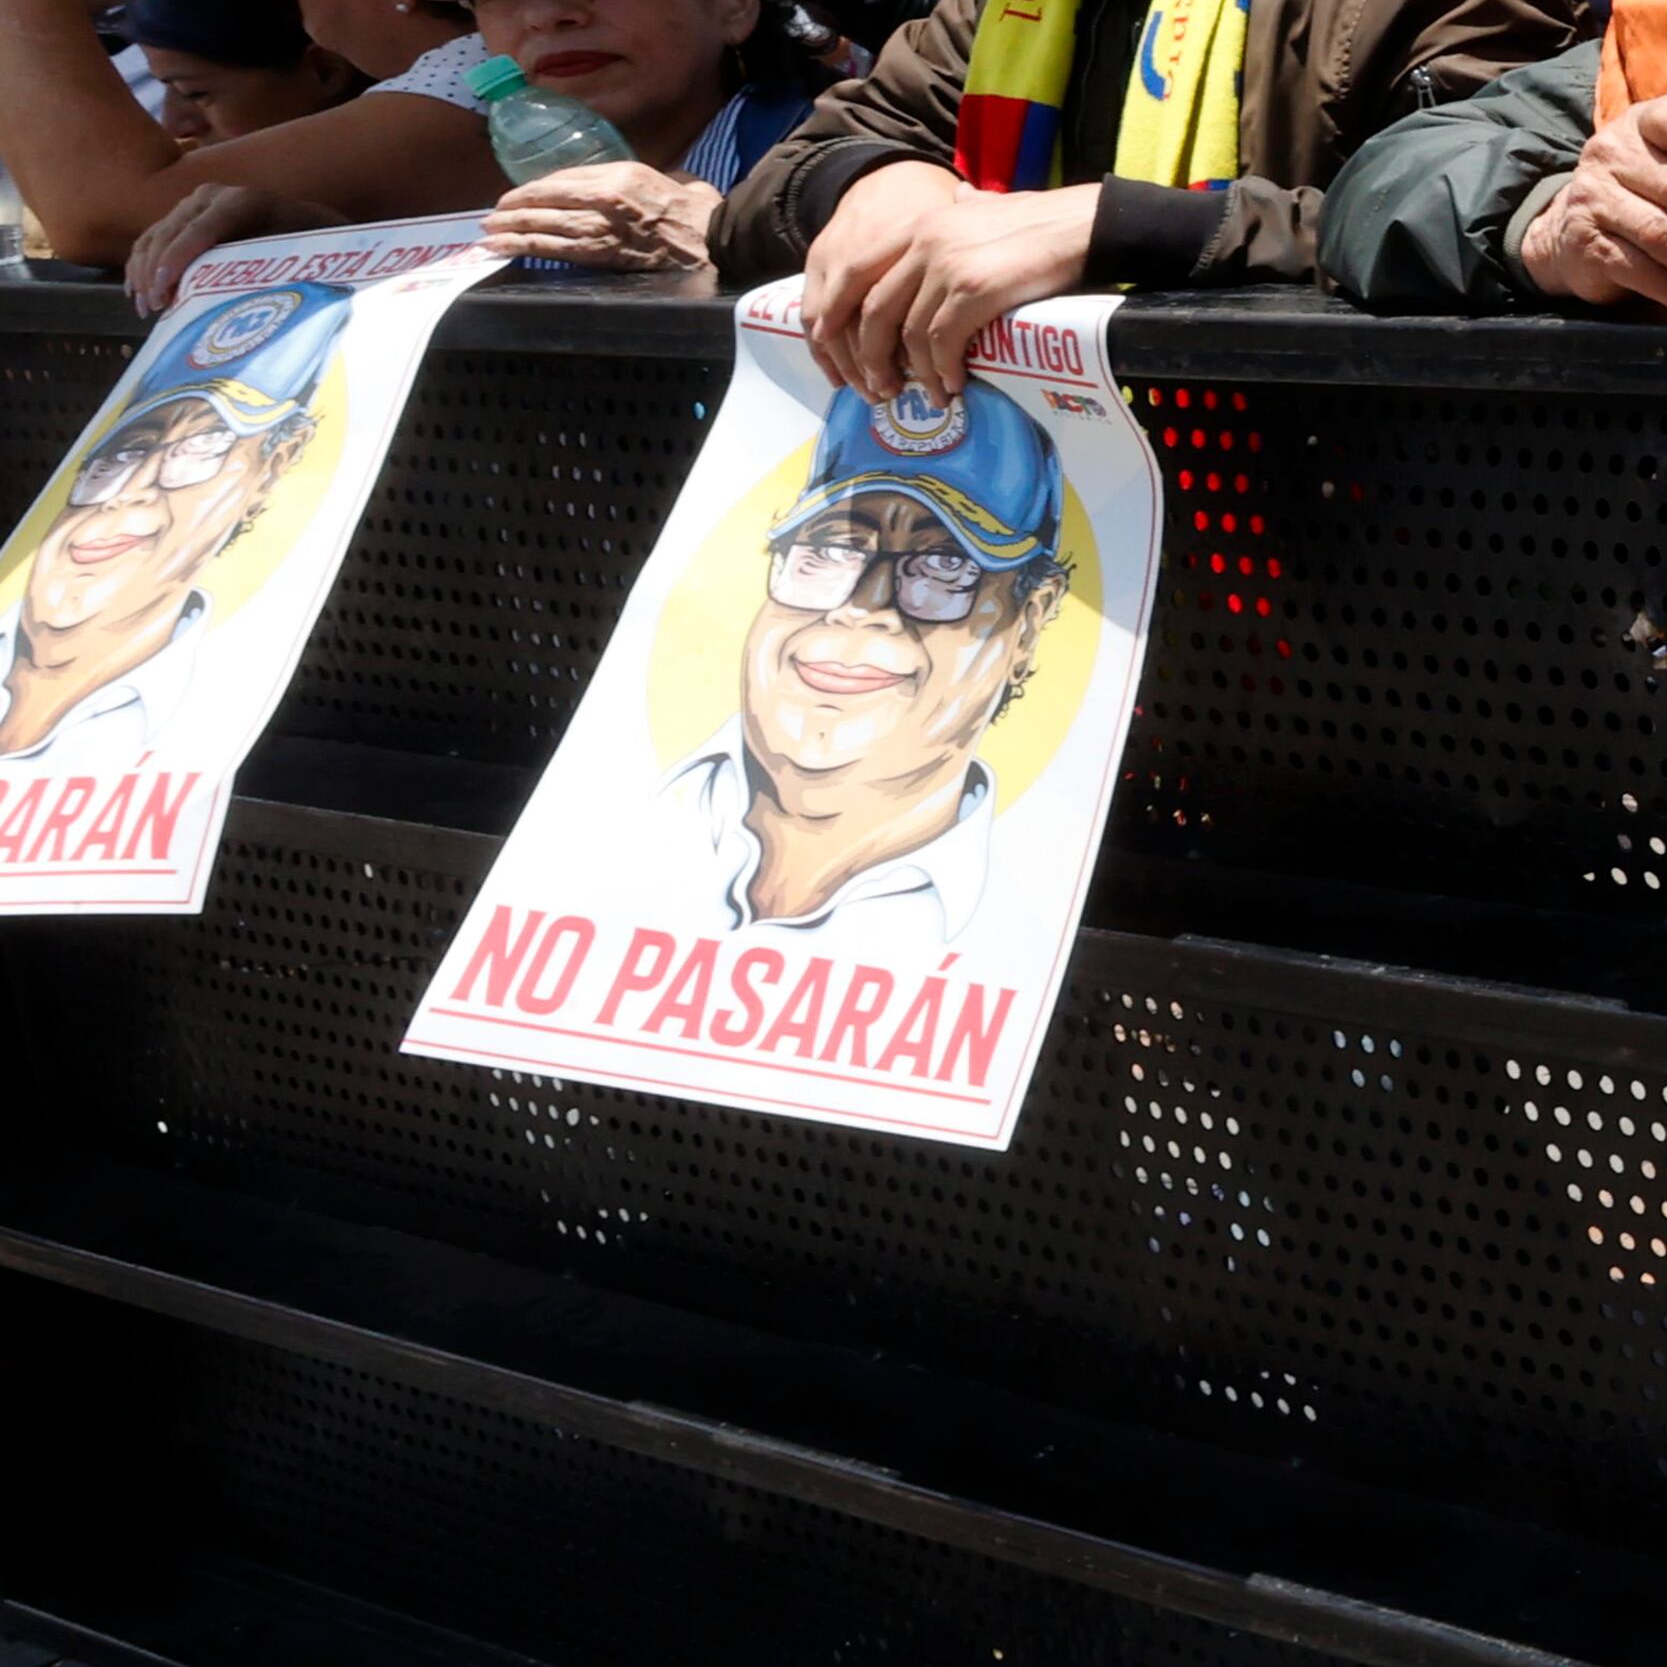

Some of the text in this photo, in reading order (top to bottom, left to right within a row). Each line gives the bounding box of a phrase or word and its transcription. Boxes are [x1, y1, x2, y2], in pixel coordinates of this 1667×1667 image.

[190, 255, 300, 289] PUEBLO
[287, 241, 384, 283] ESTÁ
[0, 751, 203, 864] ARÁN
[449, 905, 1018, 1088] NO PASARÁN
